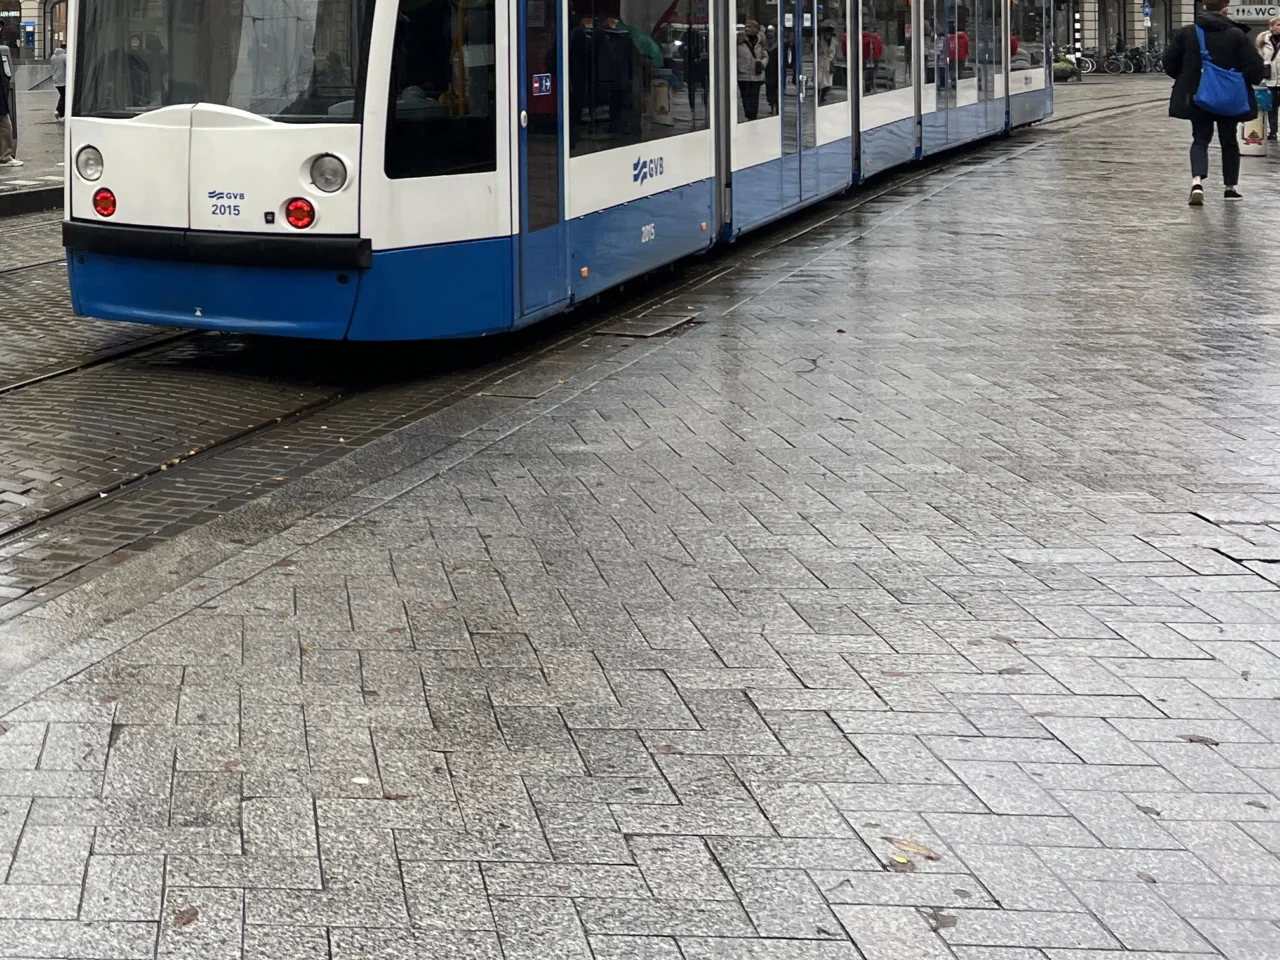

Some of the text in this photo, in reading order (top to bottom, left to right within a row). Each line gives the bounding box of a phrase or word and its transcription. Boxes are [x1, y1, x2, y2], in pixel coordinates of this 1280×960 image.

[1254, 7, 1276, 17] WC
[648, 156, 664, 178] GVB
[225, 192, 245, 200] GVB
[211, 204, 241, 216] 2015
[641, 223, 656, 243] 2015
